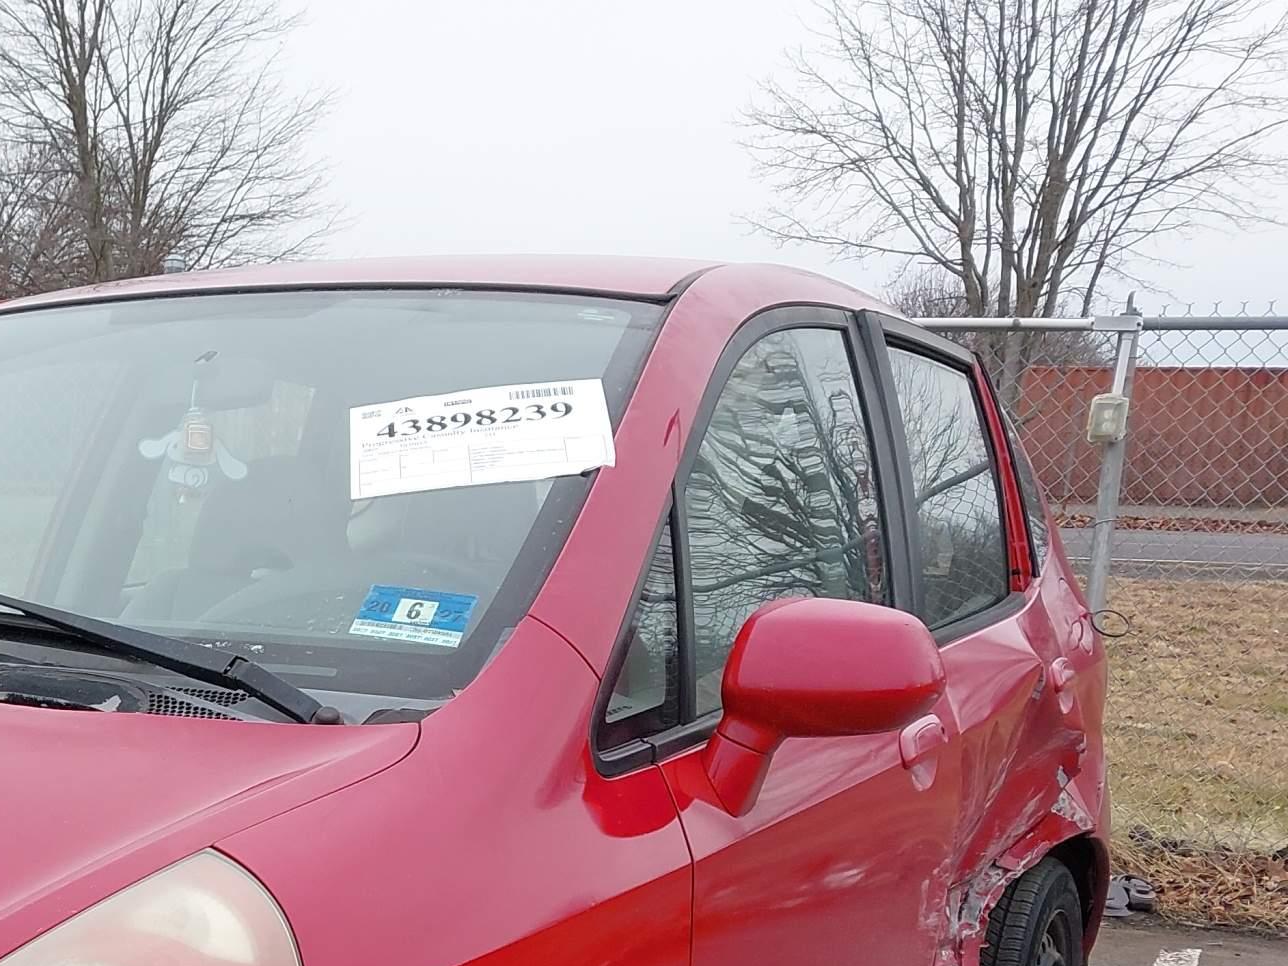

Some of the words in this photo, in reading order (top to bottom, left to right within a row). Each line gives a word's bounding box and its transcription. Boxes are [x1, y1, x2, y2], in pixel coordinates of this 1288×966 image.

[376, 401, 574, 438] 43898239
[365, 600, 391, 614] 20
[406, 601, 424, 620] 6
